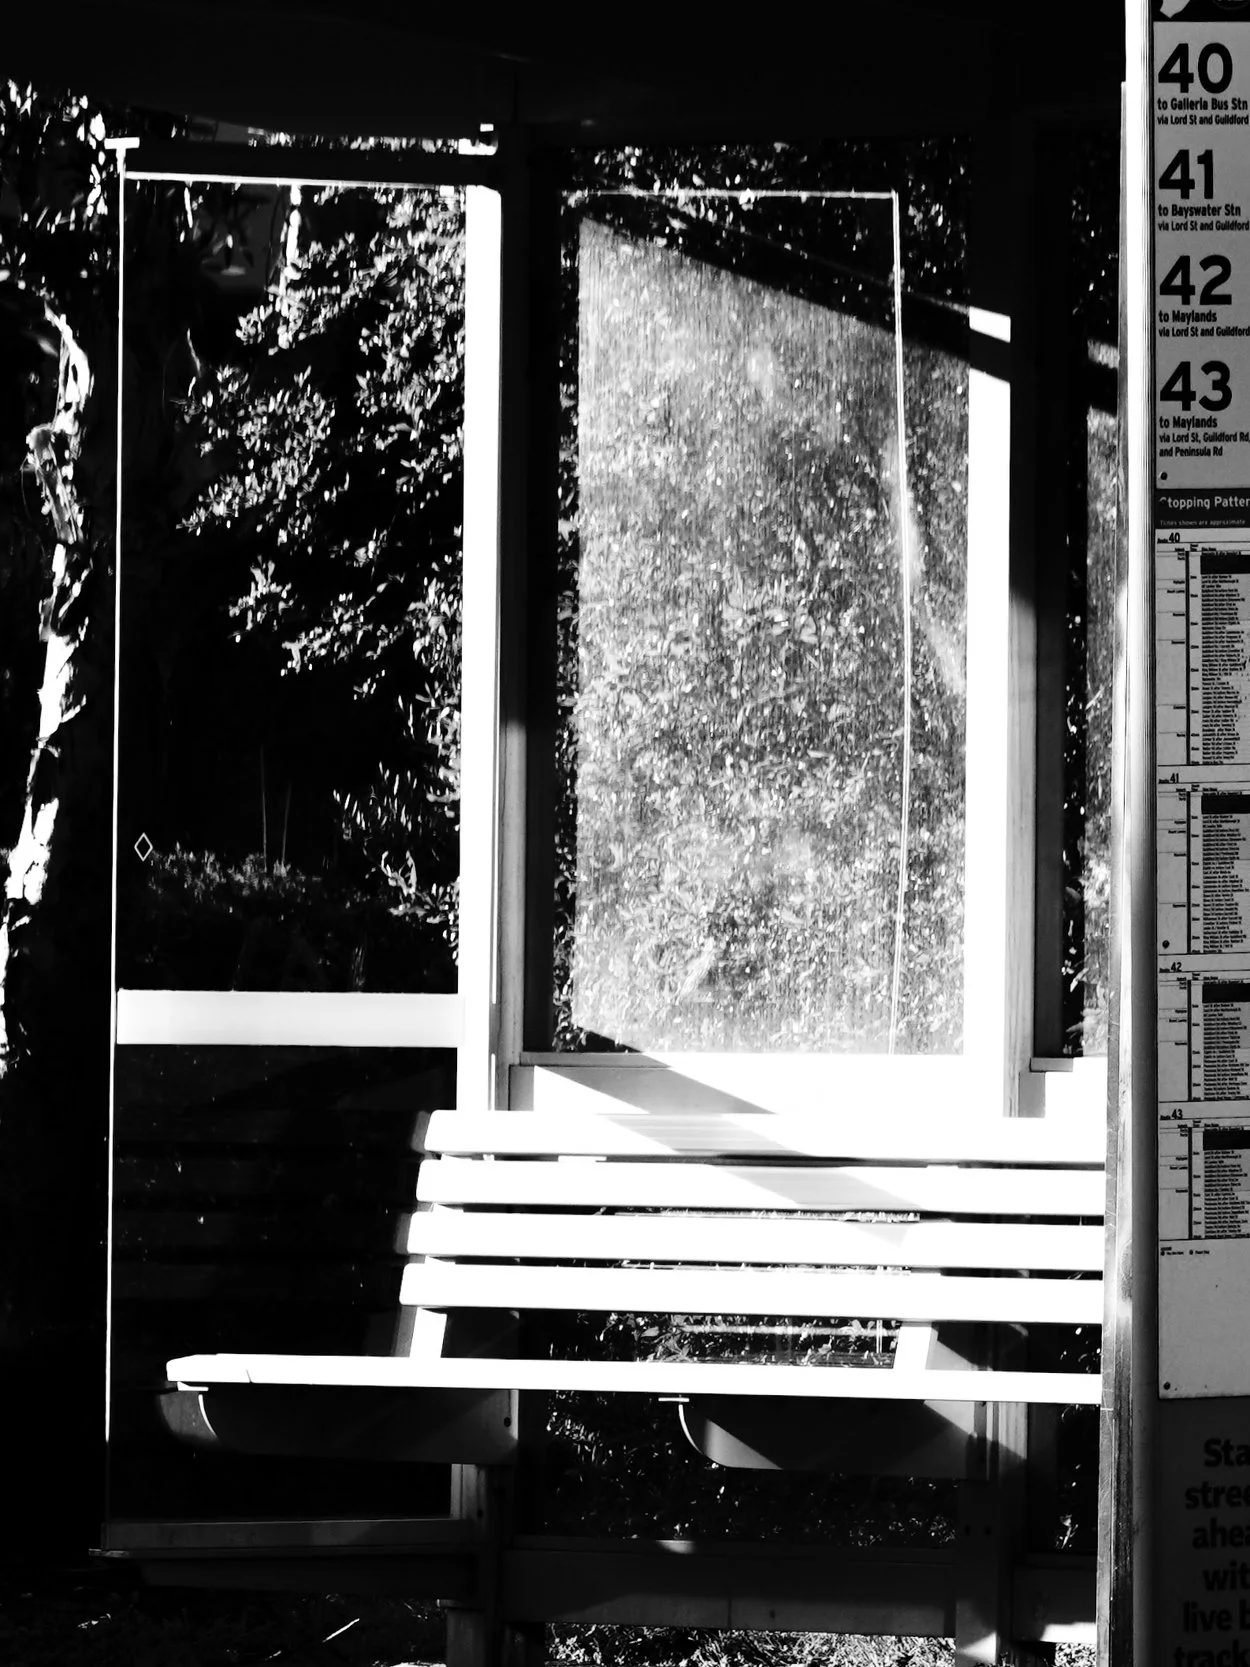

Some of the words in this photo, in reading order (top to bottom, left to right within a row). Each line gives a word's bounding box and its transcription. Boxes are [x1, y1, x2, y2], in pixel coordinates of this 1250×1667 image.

[1157, 42, 1233, 94] 40
[1157, 98, 1168, 110] to
[1170, 98, 1208, 110] Galleria
[1211, 98, 1229, 110] Bus
[1231, 98, 1248, 110] Stn
[1157, 115, 1169, 125] via
[1170, 115, 1188, 125] Lord
[1189, 115, 1197, 125] St
[1199, 115, 1213, 125] and
[1214, 115, 1249, 125] Guildford
[1158, 149, 1214, 200] 41
[1158, 204, 1169, 216] to
[1171, 204, 1222, 219] Bayswater
[1224, 204, 1241, 216] Stn
[1158, 221, 1169, 231] via
[1171, 221, 1188, 231] Lord
[1190, 221, 1198, 231] St
[1199, 221, 1214, 231] and
[1215, 221, 1250, 231] Guildford
[1159, 254, 1232, 306] 42
[1158, 310, 1169, 323] to
[1172, 310, 1217, 325] Maylands
[1158, 326, 1170, 337] via
[1171, 326, 1189, 337] Lord
[1190, 326, 1199, 337] St
[1200, 326, 1214, 337] and
[1216, 326, 1250, 337] Guildford
[1159, 360, 1233, 412] 43
[1159, 416, 1170, 428] to
[1172, 416, 1218, 431] Maylands
[1159, 432, 1171, 443] via
[1172, 432, 1190, 443] Lord
[1191, 432, 1201, 444] St,
[1202, 432, 1238, 443] Guildford
[1240, 432, 1250, 443] Rd,
[1159, 446, 1173, 457] and
[1175, 446, 1211, 457] Peninsula
[1213, 446, 1223, 457] Rd
[1168, 532, 1181, 543] 40
[1170, 773, 1179, 783] 41
[1170, 962, 1182, 972] 42
[1171, 1109, 1183, 1119] 43
[1183, 1600, 1232, 1632] live
